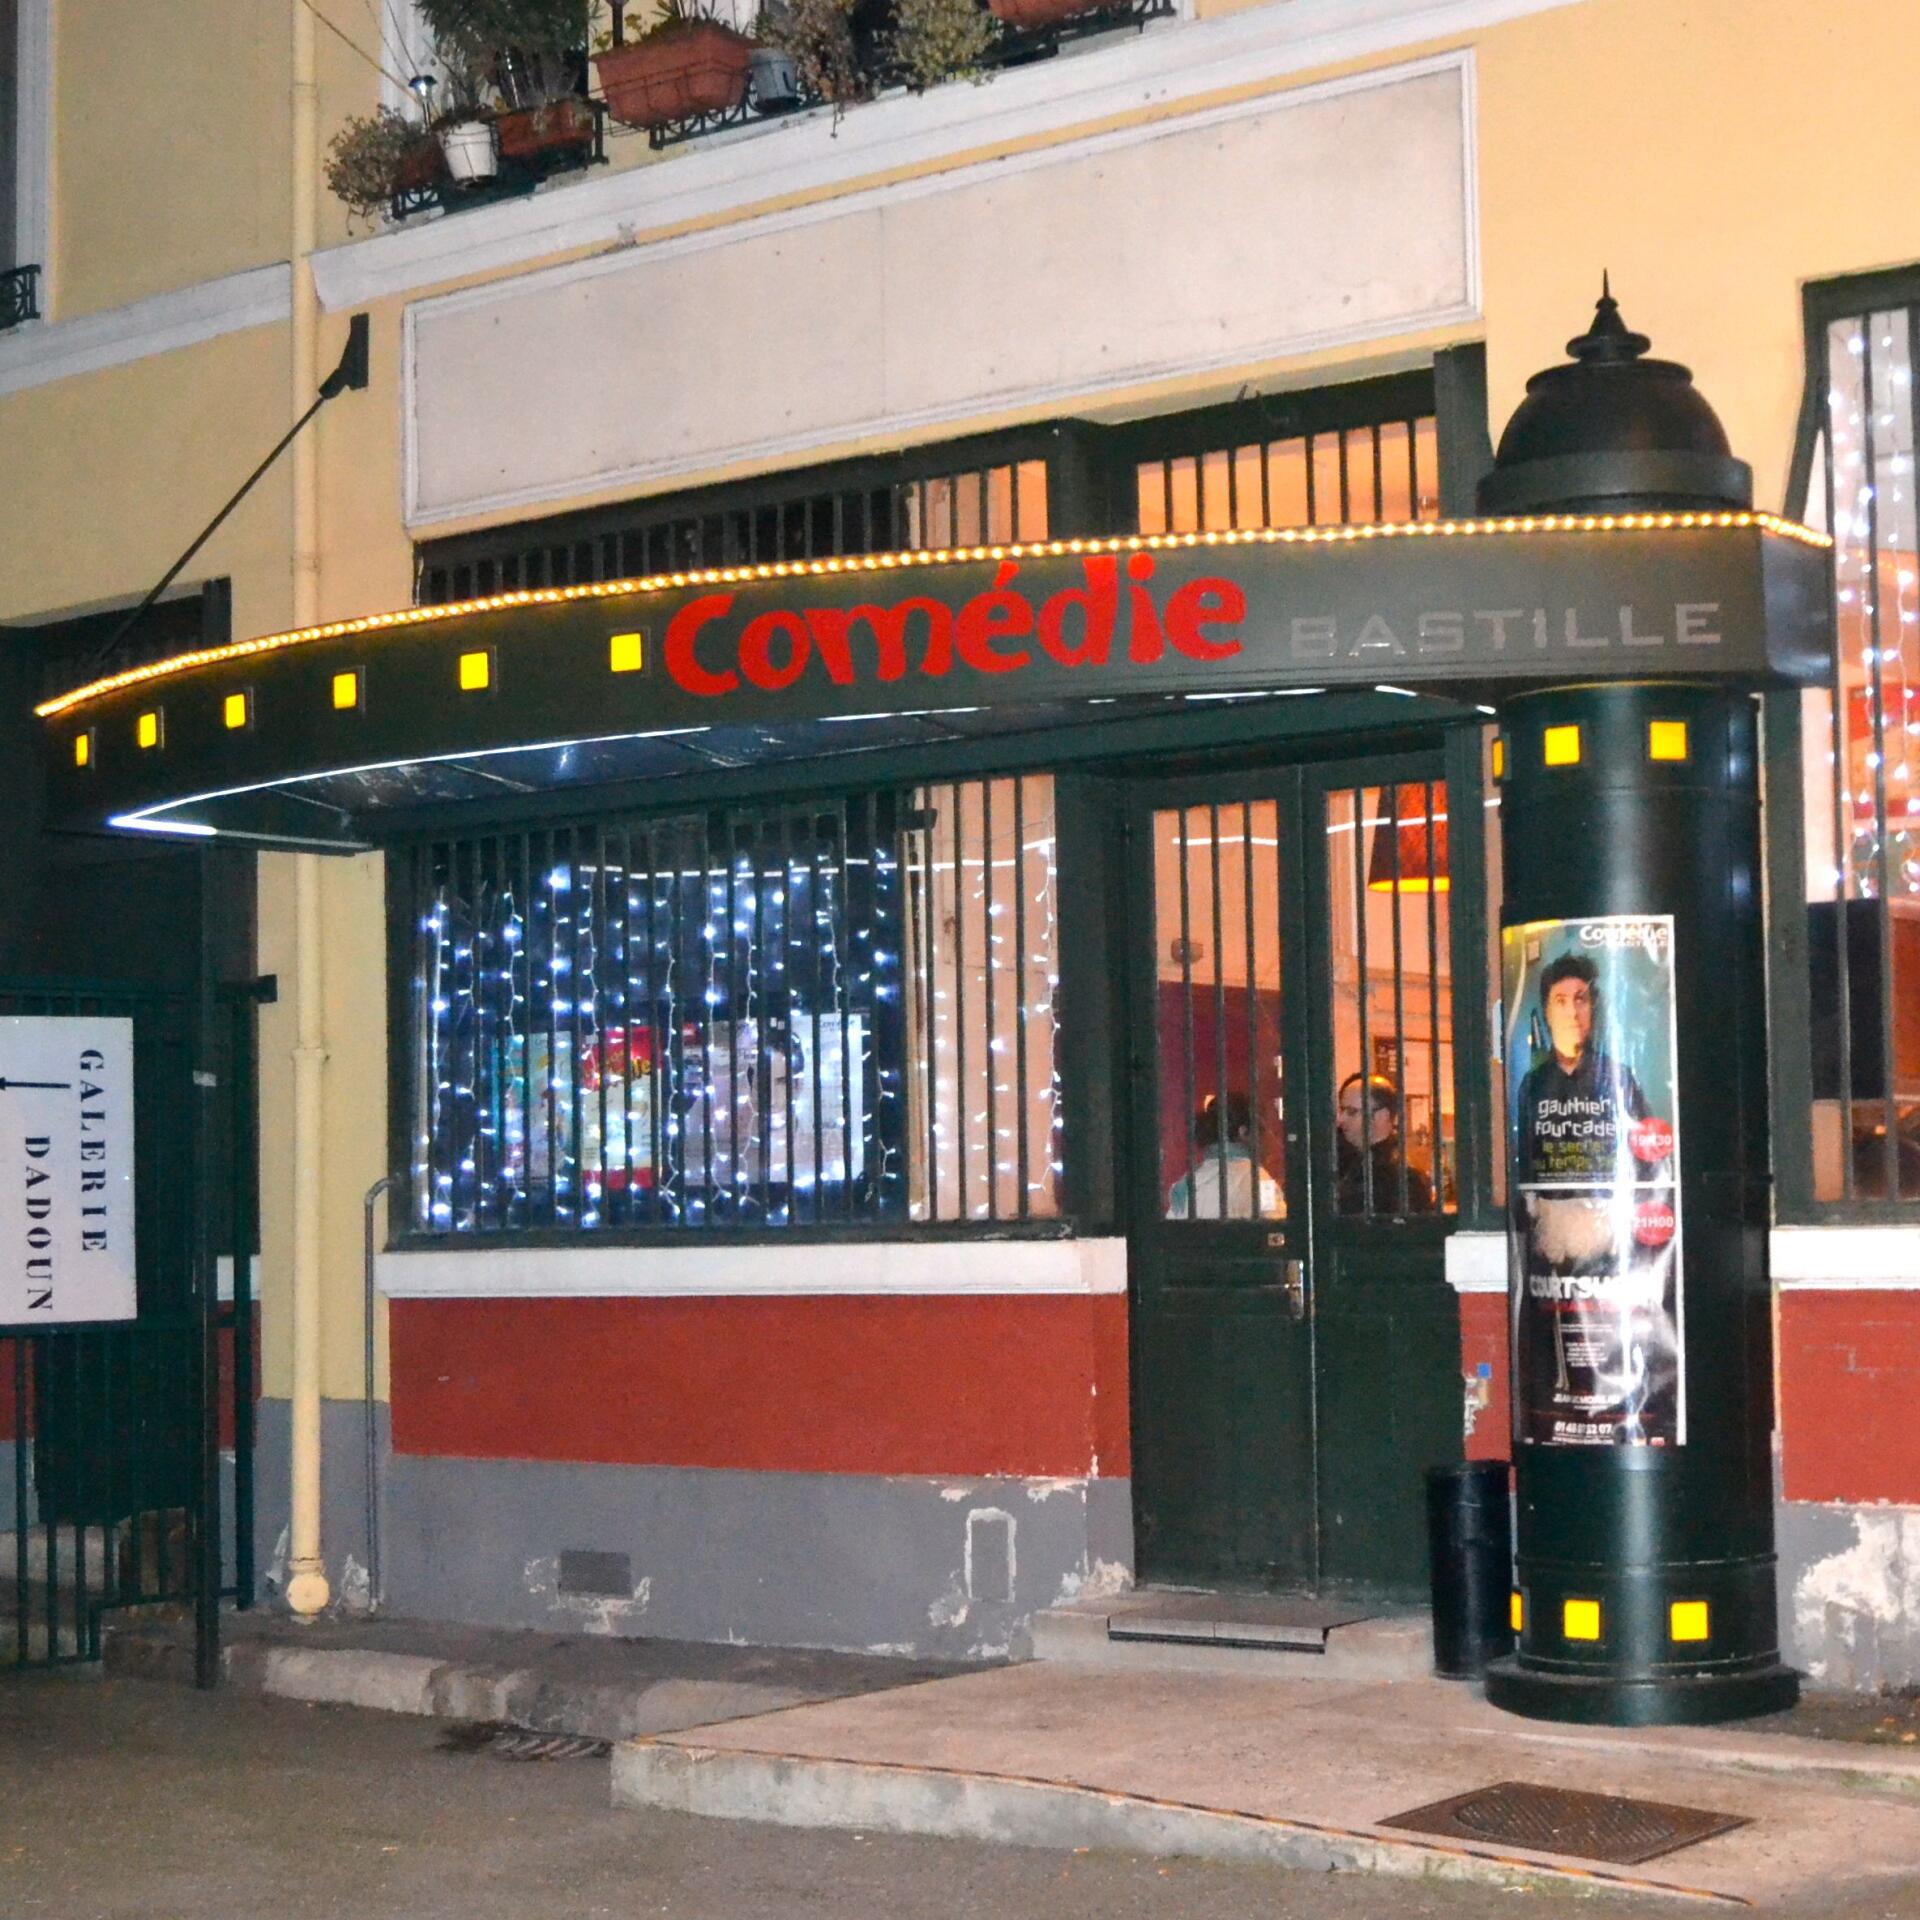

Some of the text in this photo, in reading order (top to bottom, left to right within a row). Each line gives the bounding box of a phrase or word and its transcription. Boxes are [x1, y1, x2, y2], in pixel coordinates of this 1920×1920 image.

[663, 552, 1248, 696] Comédie
[1290, 602, 1722, 657] BASTILLE
[25, 1136, 52, 1310] DADOUN
[79, 1050, 107, 1251] GALERIE
